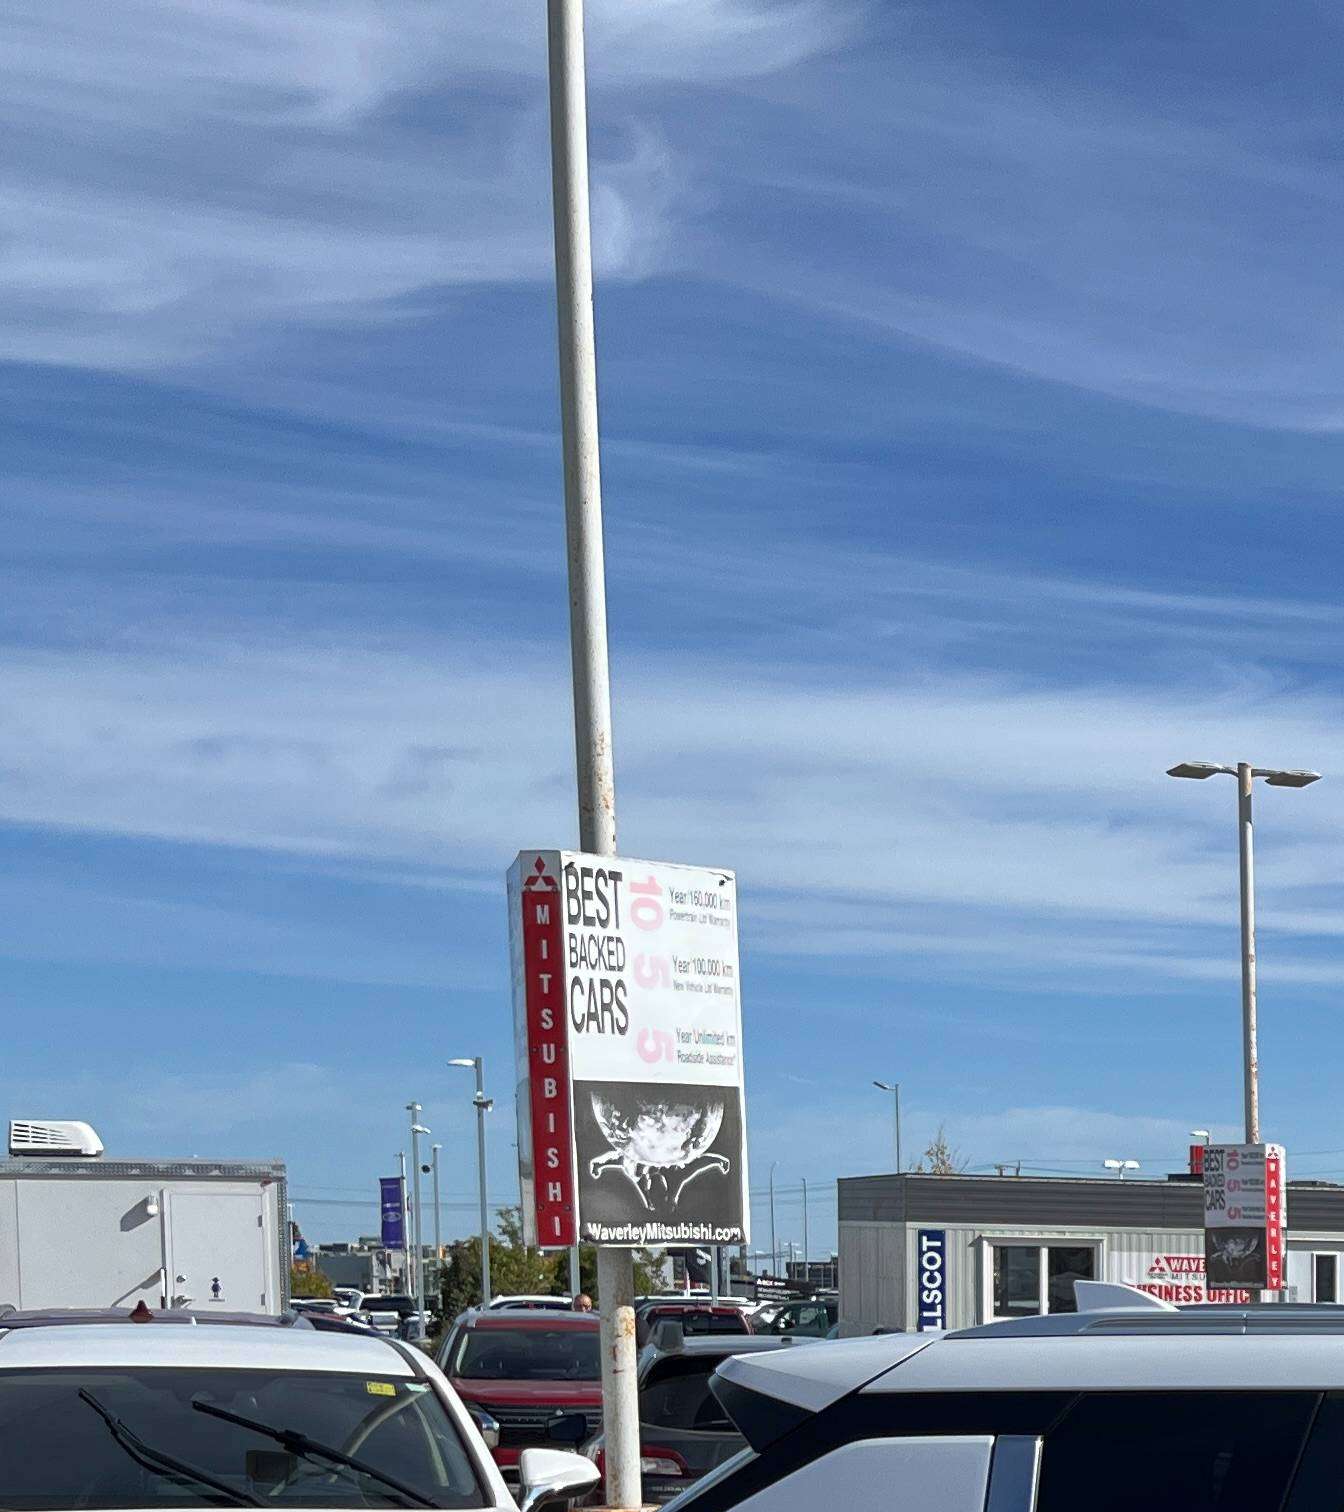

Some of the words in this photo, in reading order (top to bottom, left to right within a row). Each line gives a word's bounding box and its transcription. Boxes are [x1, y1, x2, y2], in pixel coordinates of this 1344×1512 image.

[565, 866, 623, 929] BEST
[568, 932, 626, 972] BACKED
[570, 976, 629, 1035] CARS
[535, 903, 562, 1237] MITSUBISHI
[587, 1222, 741, 1245] WaverleyMitsubishi.com
[1170, 1258, 1206, 1272] WAVE
